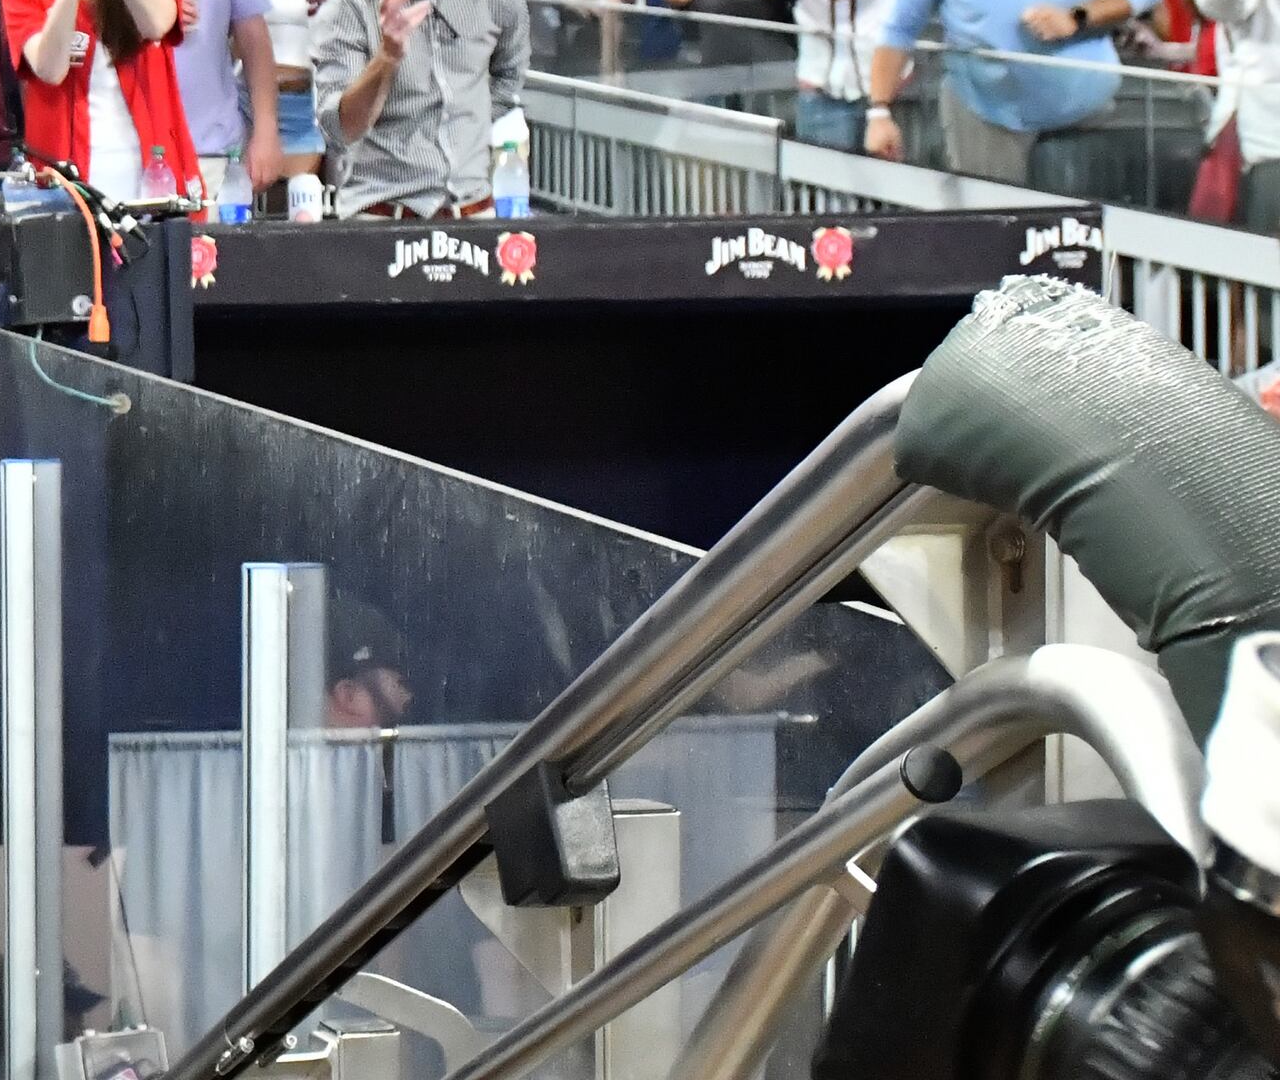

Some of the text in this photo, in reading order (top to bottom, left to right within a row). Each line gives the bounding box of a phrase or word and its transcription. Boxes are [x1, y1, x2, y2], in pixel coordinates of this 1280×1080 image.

[387, 230, 490, 278] JIM BEAM
[705, 228, 806, 276] JIM BEAM
[1020, 226, 1062, 266] JIM
[1061, 217, 1103, 252] BEA
